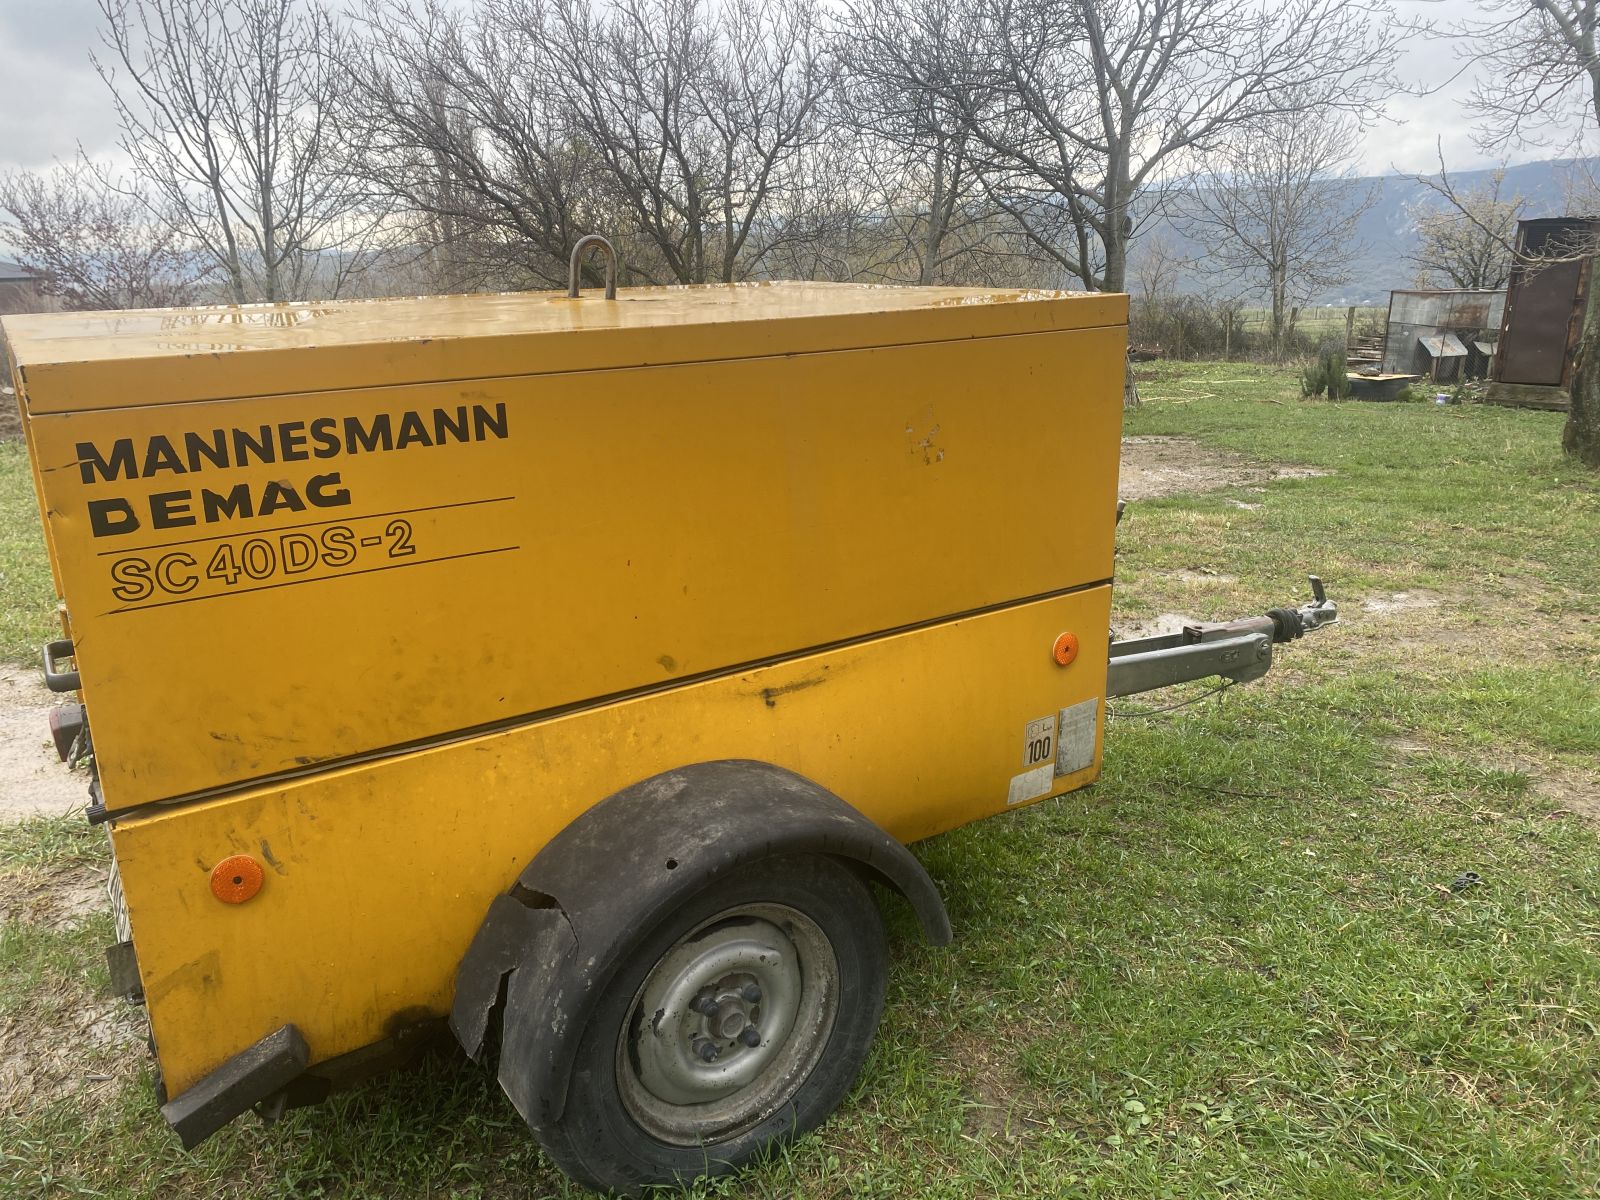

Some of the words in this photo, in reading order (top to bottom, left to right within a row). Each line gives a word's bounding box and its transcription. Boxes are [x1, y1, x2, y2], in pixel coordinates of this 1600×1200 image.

[75, 402, 509, 485] MANNESMANN
[87, 471, 352, 538] DEMAG
[1028, 735, 1051, 764] 100
